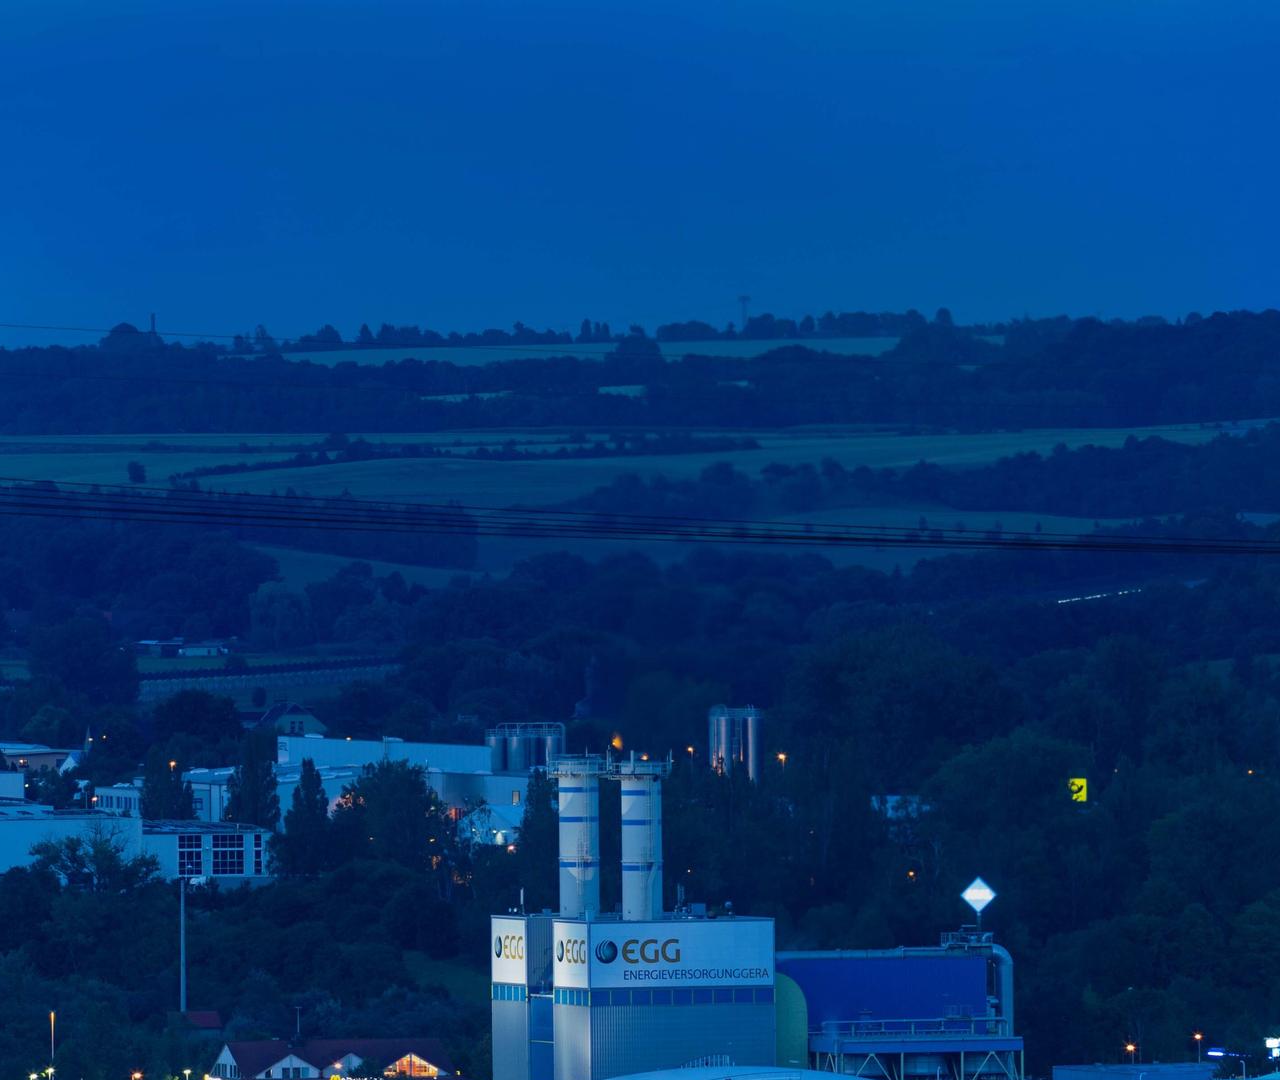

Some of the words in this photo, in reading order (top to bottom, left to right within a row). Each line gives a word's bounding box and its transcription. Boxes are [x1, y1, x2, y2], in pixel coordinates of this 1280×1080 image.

[503, 935, 525, 960] EGG
[565, 938, 587, 964] EGG
[621, 938, 681, 964] EGG
